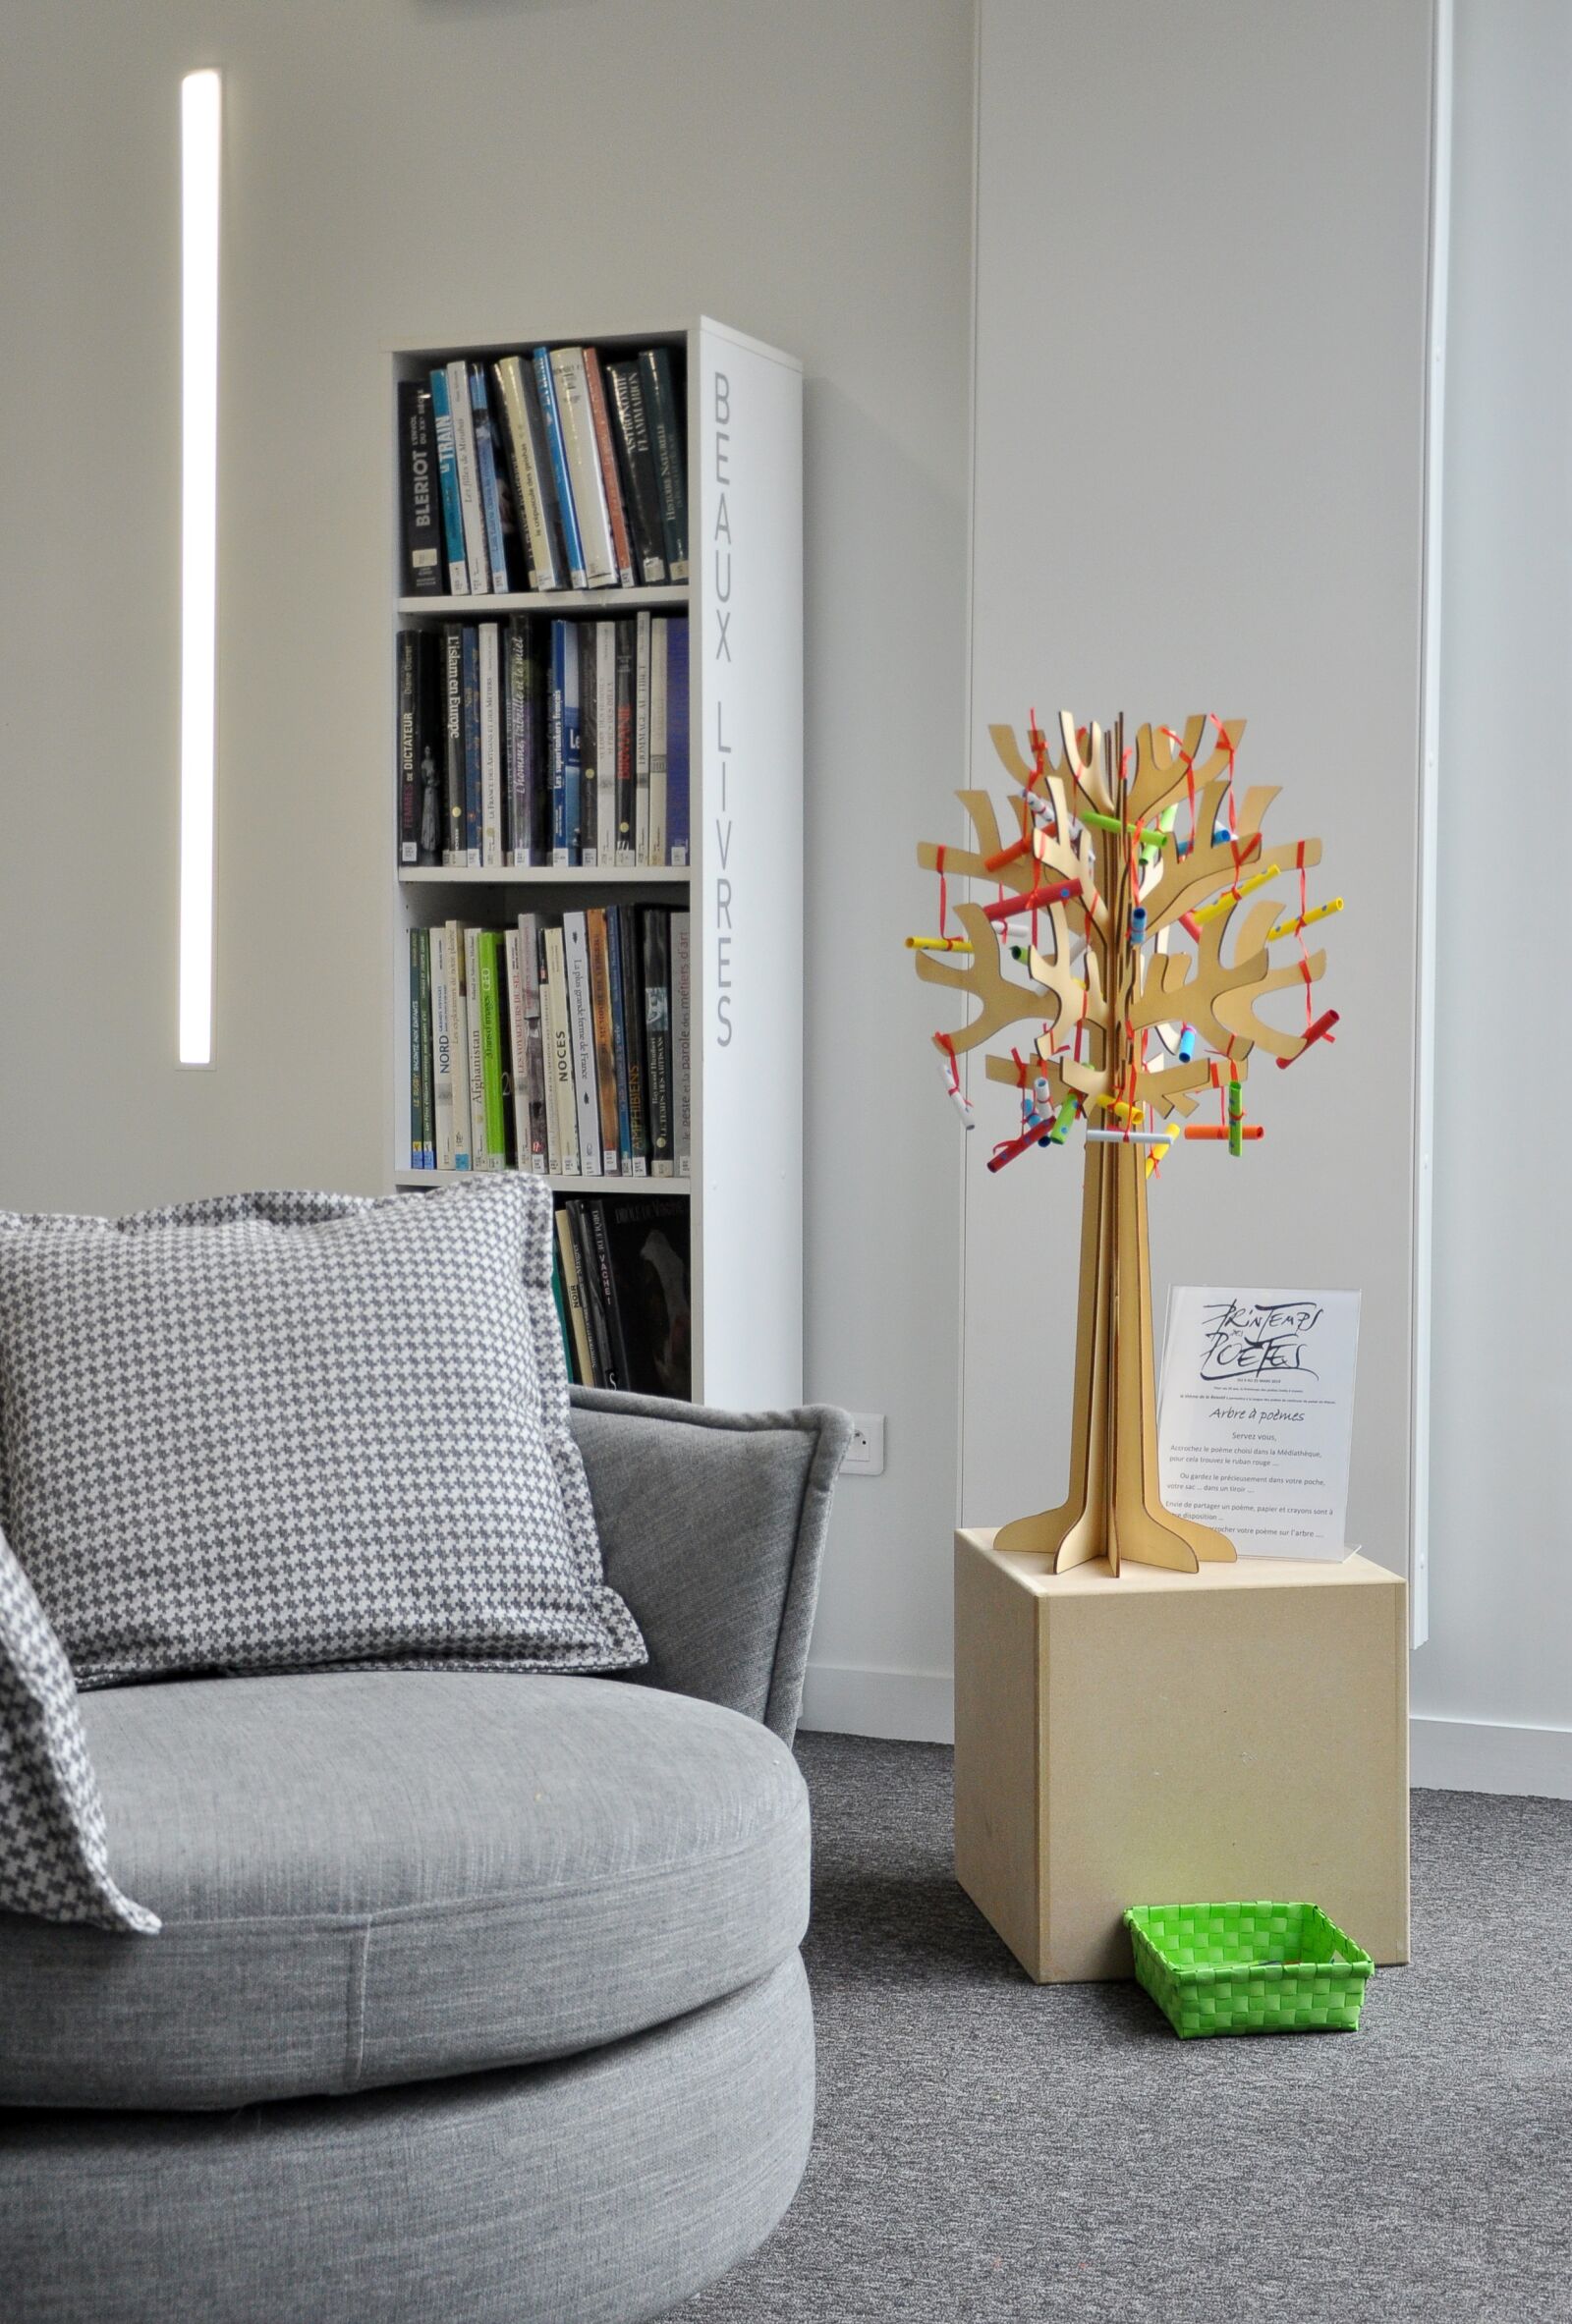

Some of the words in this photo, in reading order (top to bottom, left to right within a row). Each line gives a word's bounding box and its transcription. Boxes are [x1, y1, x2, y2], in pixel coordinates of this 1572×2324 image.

[618, 376, 636, 454] ASTRONOMIE
[628, 372, 649, 452] FLAMMARION
[435, 415, 455, 464] TRAIN
[656, 424, 671, 476] NATURELLE
[413, 450, 430, 526] BLERIOT
[663, 478, 676, 521] HISTOIRE
[714, 371, 732, 663] BEAUX
[448, 636, 460, 678] L'islam
[449, 680, 459, 693] en
[552, 690, 562, 718] français
[447, 695, 460, 739] Europe
[512, 692, 525, 737] l'abeille
[404, 712, 413, 770] DICTATEUR
[552, 720, 564, 773] supertankers
[553, 774, 562, 789] Les
[716, 700, 733, 1048] LIVRES
[573, 959, 582, 970] La
[573, 971, 582, 988] plus
[574, 988, 587, 1018] grande
[678, 964, 689, 1009] métiers
[578, 1017, 587, 1040] ferme
[580, 1041, 589, 1052] de
[439, 1034, 450, 1074] NORD
[472, 1029, 485, 1104] Afghanistan
[556, 1030, 569, 1081] NOCES
[679, 1030, 690, 1069] parole
[630, 1065, 642, 1149] AMPHIBIENS
[570, 1285, 581, 1308] NOIR
[1208, 1407, 1246, 1420] Arbre
[1248, 1407, 1257, 1419] à
[1258, 1409, 1305, 1424] poèmes
[1210, 1446, 1233, 1455] poème
[1277, 1449, 1321, 1459] Médiathèque,
[1231, 1432, 1257, 1441] Servez
[1220, 1475, 1267, 1484] précieusement
[1304, 1478, 1326, 1487] poche,
[1183, 1513, 1217, 1522] disposition
[1193, 1502, 1220, 1511] partager
[1231, 1504, 1257, 1513] poème,
[1257, 1506, 1277, 1515] papier
[1255, 1527, 1277, 1536] poème
[1290, 1528, 1315, 1537] l'arbre
